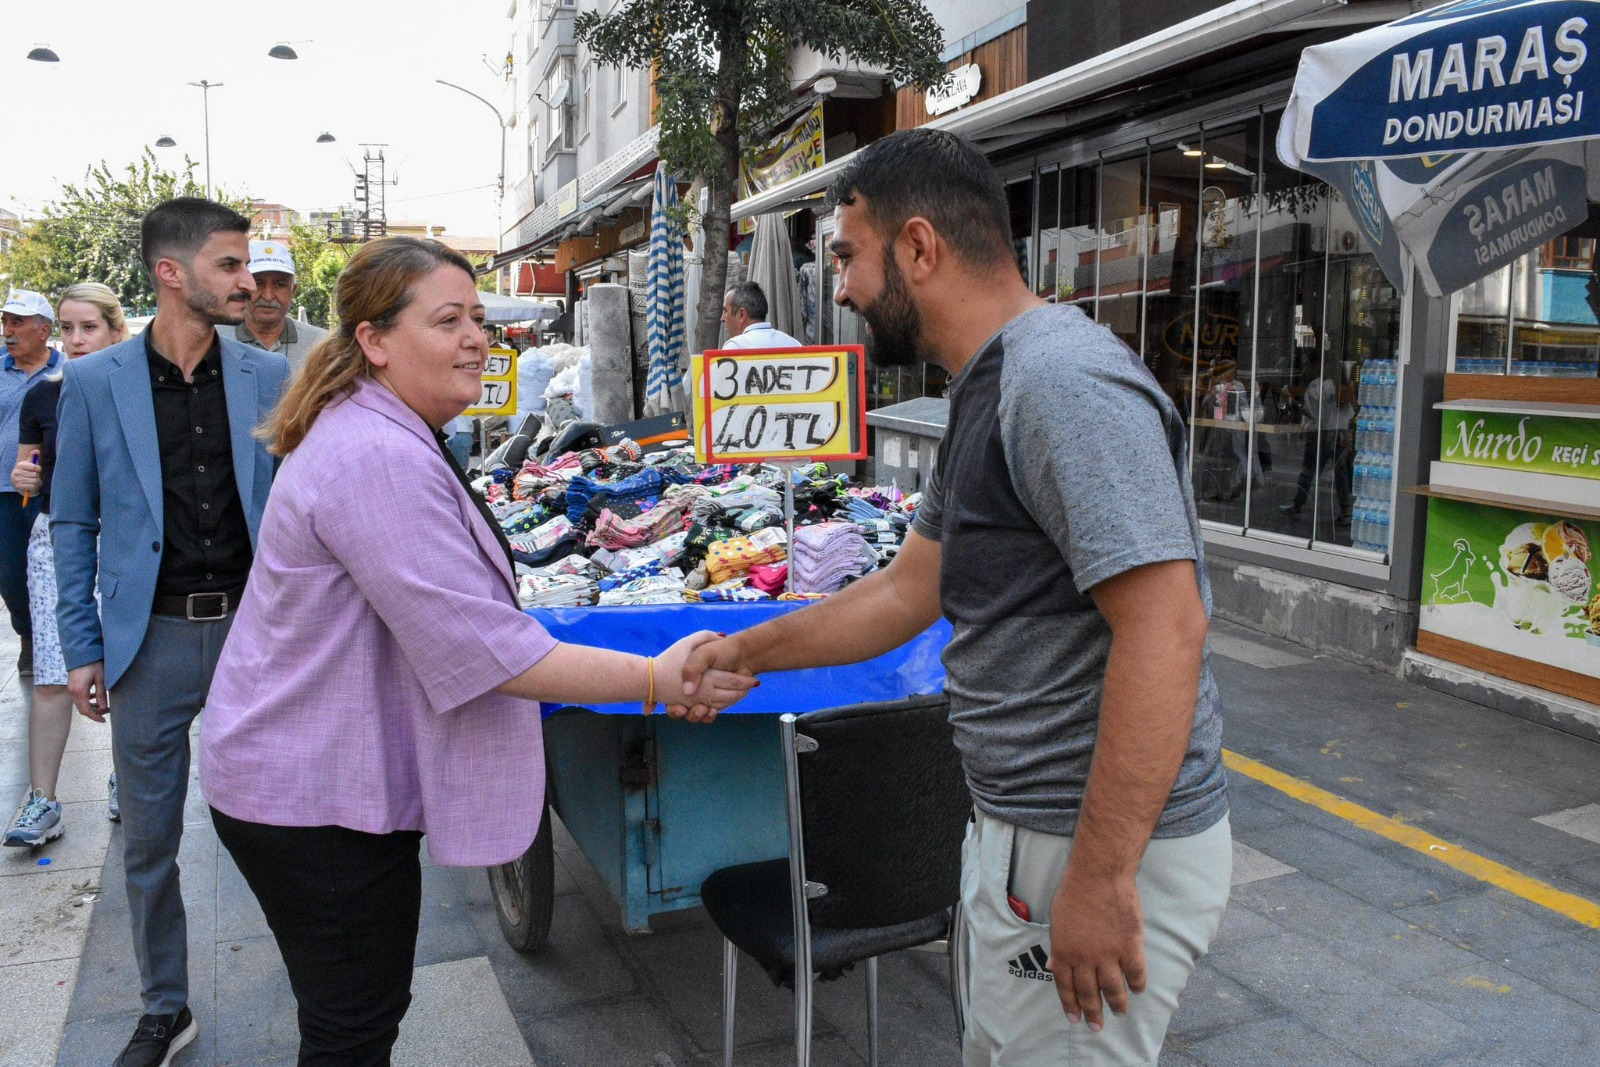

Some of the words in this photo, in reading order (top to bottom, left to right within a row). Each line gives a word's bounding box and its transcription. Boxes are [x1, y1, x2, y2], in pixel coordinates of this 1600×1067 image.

[1389, 17, 1588, 103] MARAŞ
[1383, 91, 1583, 145] DONDURMASI
[714, 358, 738, 400] 3
[745, 365, 829, 394] ADET
[713, 403, 767, 454] 40
[775, 412, 826, 450] TL
[1446, 416, 1542, 463] Nurdo
[1552, 444, 1588, 468] KEÇİ
[1008, 966, 1053, 981] adidas
